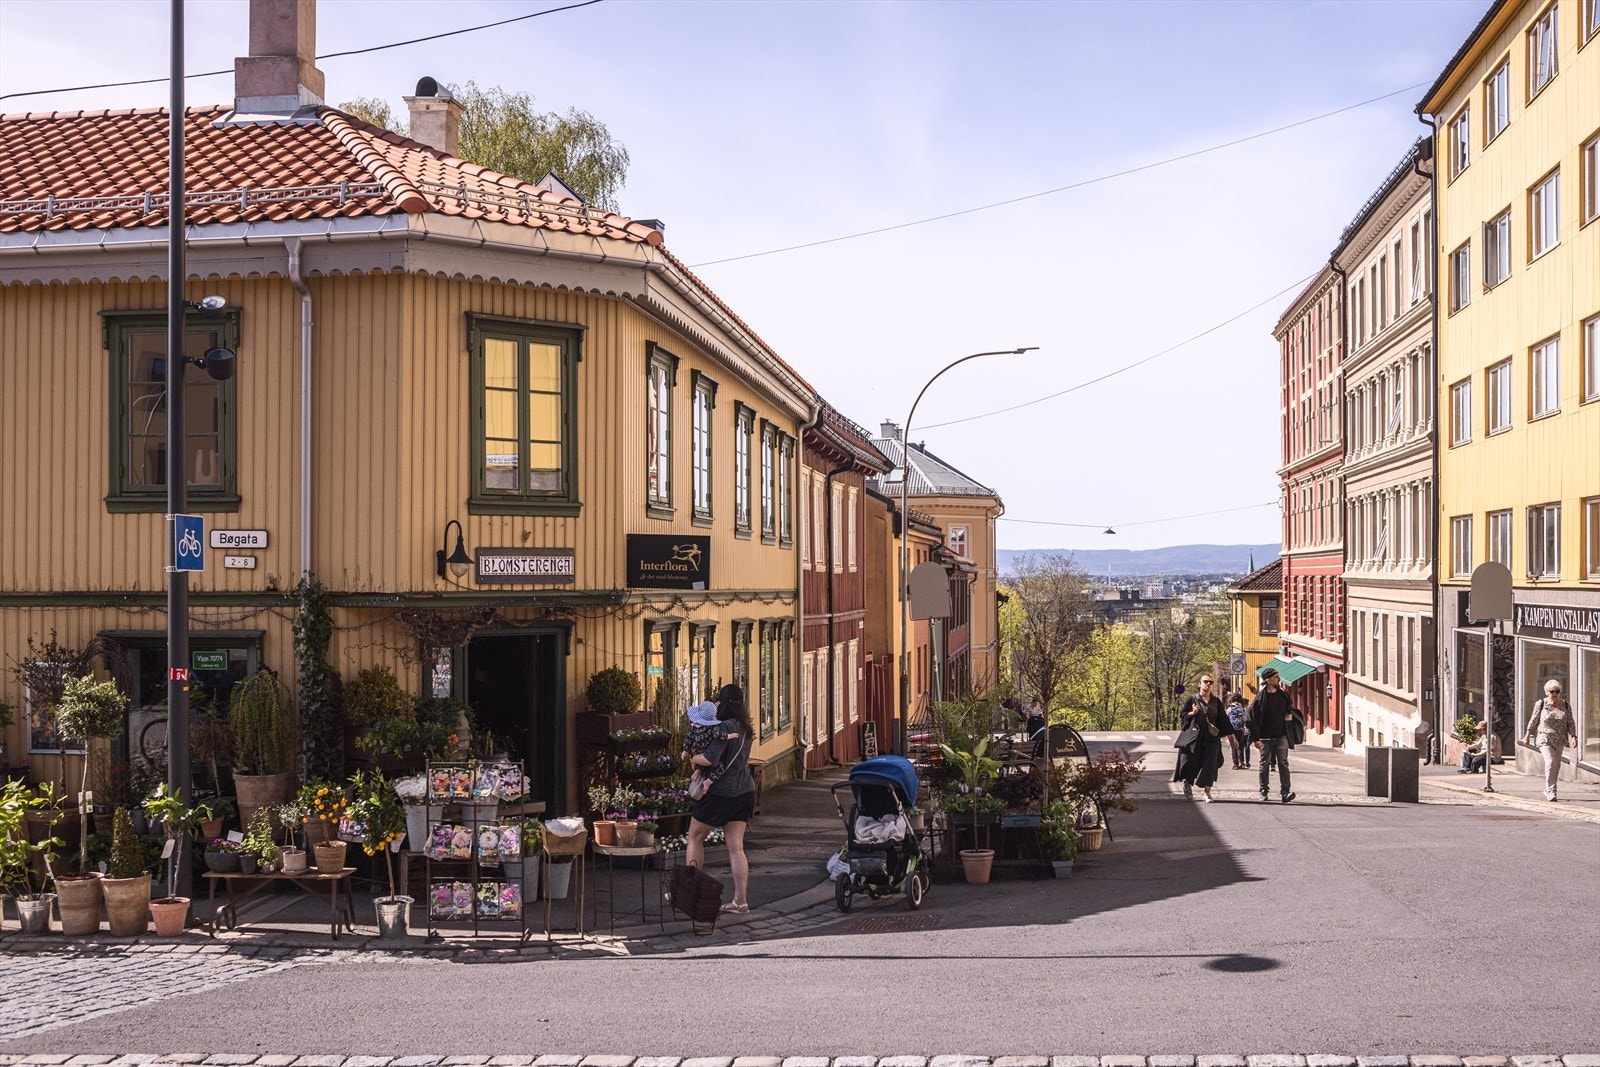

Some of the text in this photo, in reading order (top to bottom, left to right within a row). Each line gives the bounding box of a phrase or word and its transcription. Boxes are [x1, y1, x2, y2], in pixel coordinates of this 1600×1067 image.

[219, 532, 258, 546] Bøgata
[484, 559, 571, 573] BLOMSTERENGA
[640, 560, 688, 571] Interflora
[1524, 606, 1554, 628] KAMPEN
